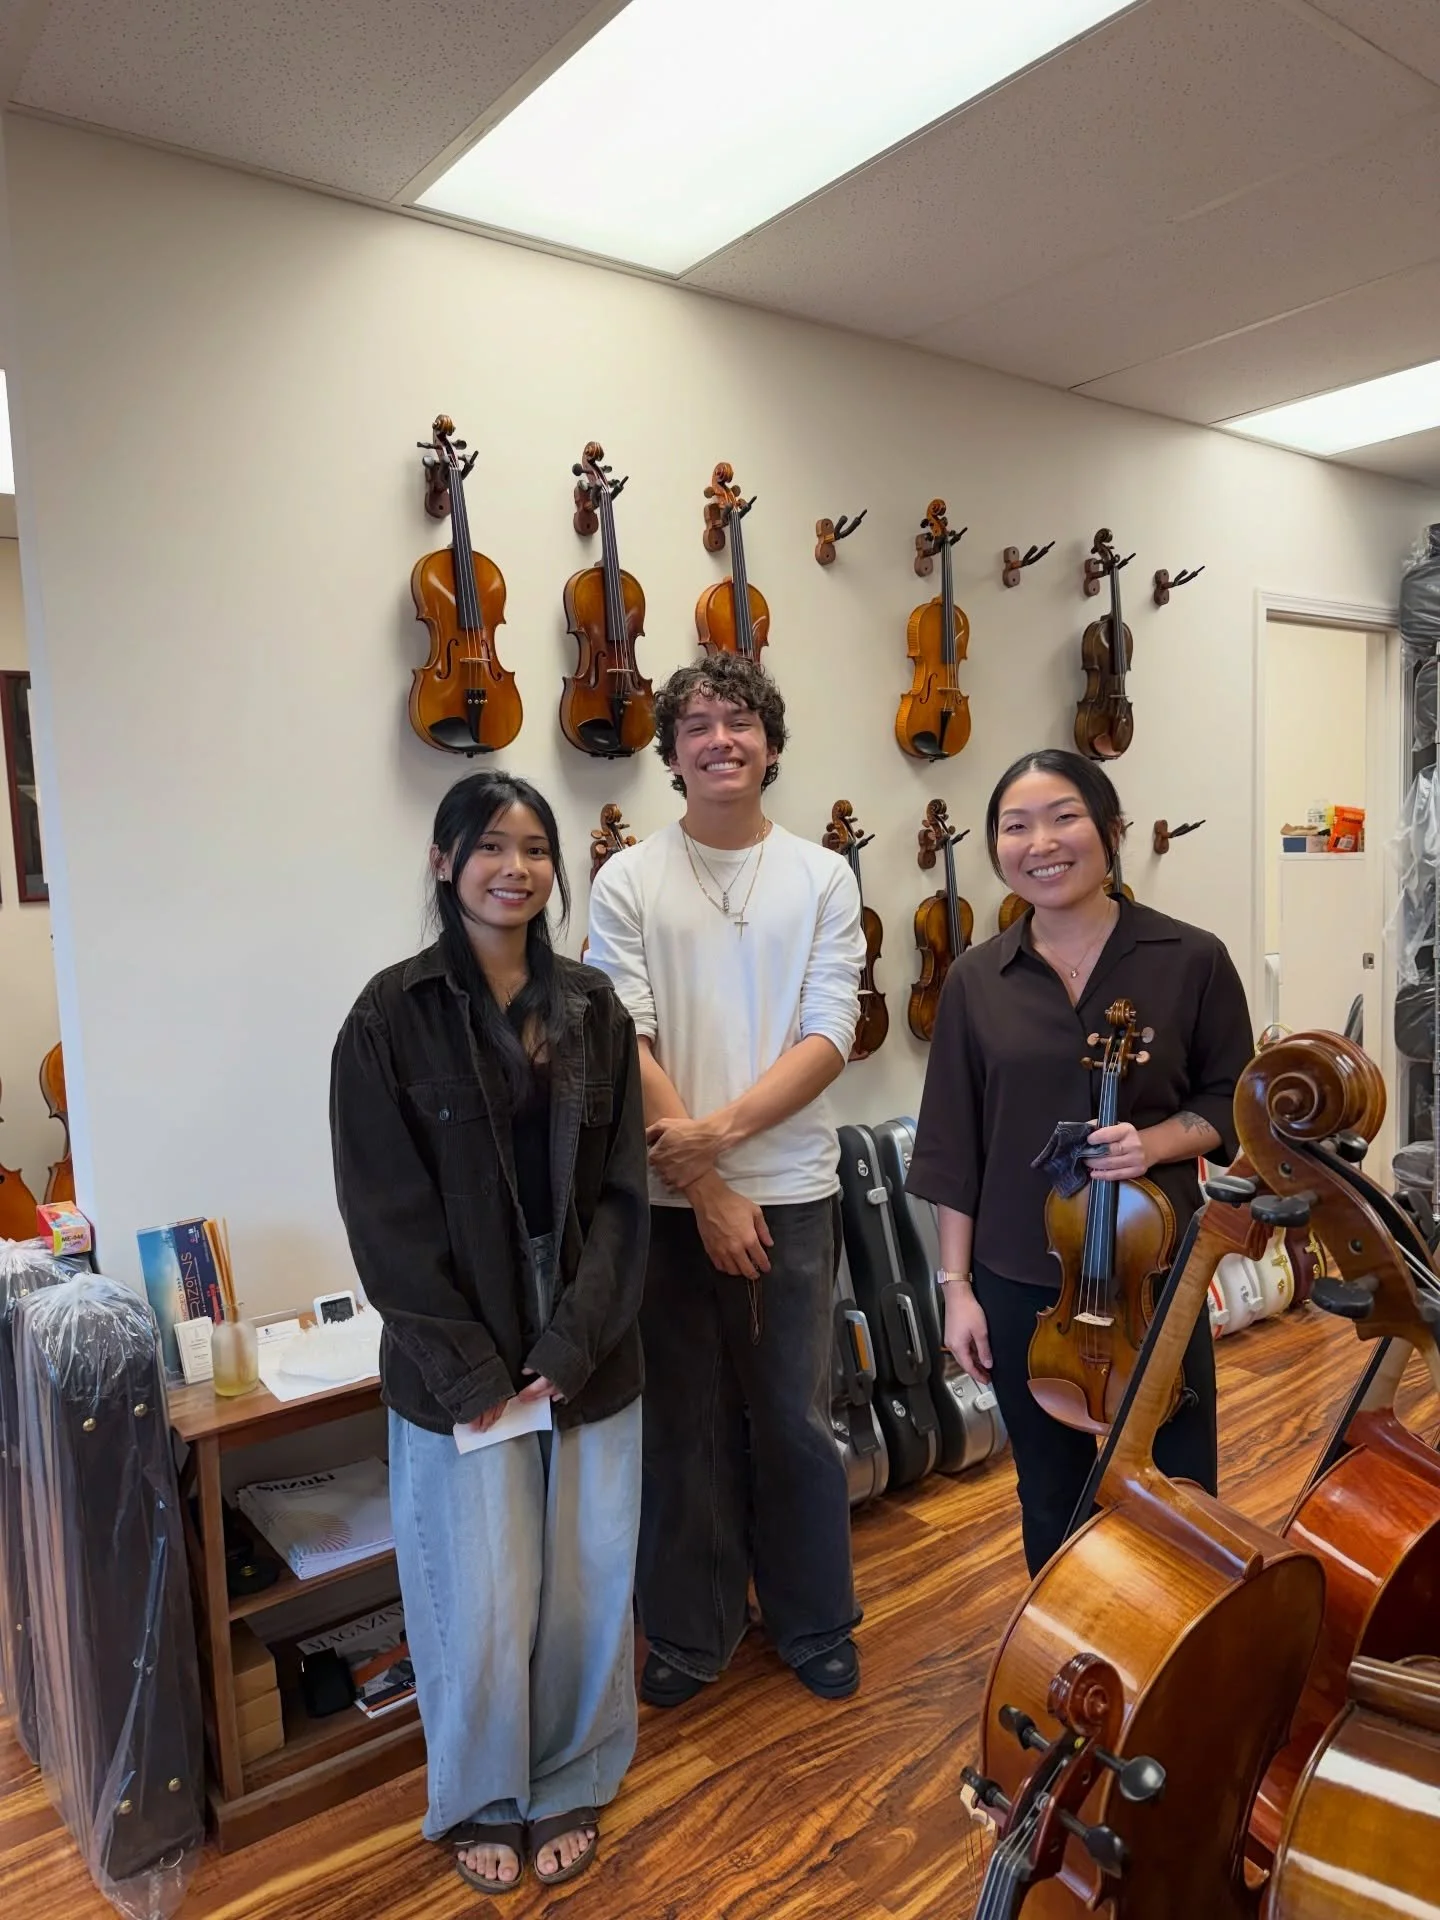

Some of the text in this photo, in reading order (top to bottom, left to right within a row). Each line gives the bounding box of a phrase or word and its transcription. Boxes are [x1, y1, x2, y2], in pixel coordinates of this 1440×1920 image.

[181, 1252, 200, 1318] RIZONS
[256, 1472, 335, 1491] Suzuki
[305, 1605, 404, 1650] MAGAZIN
